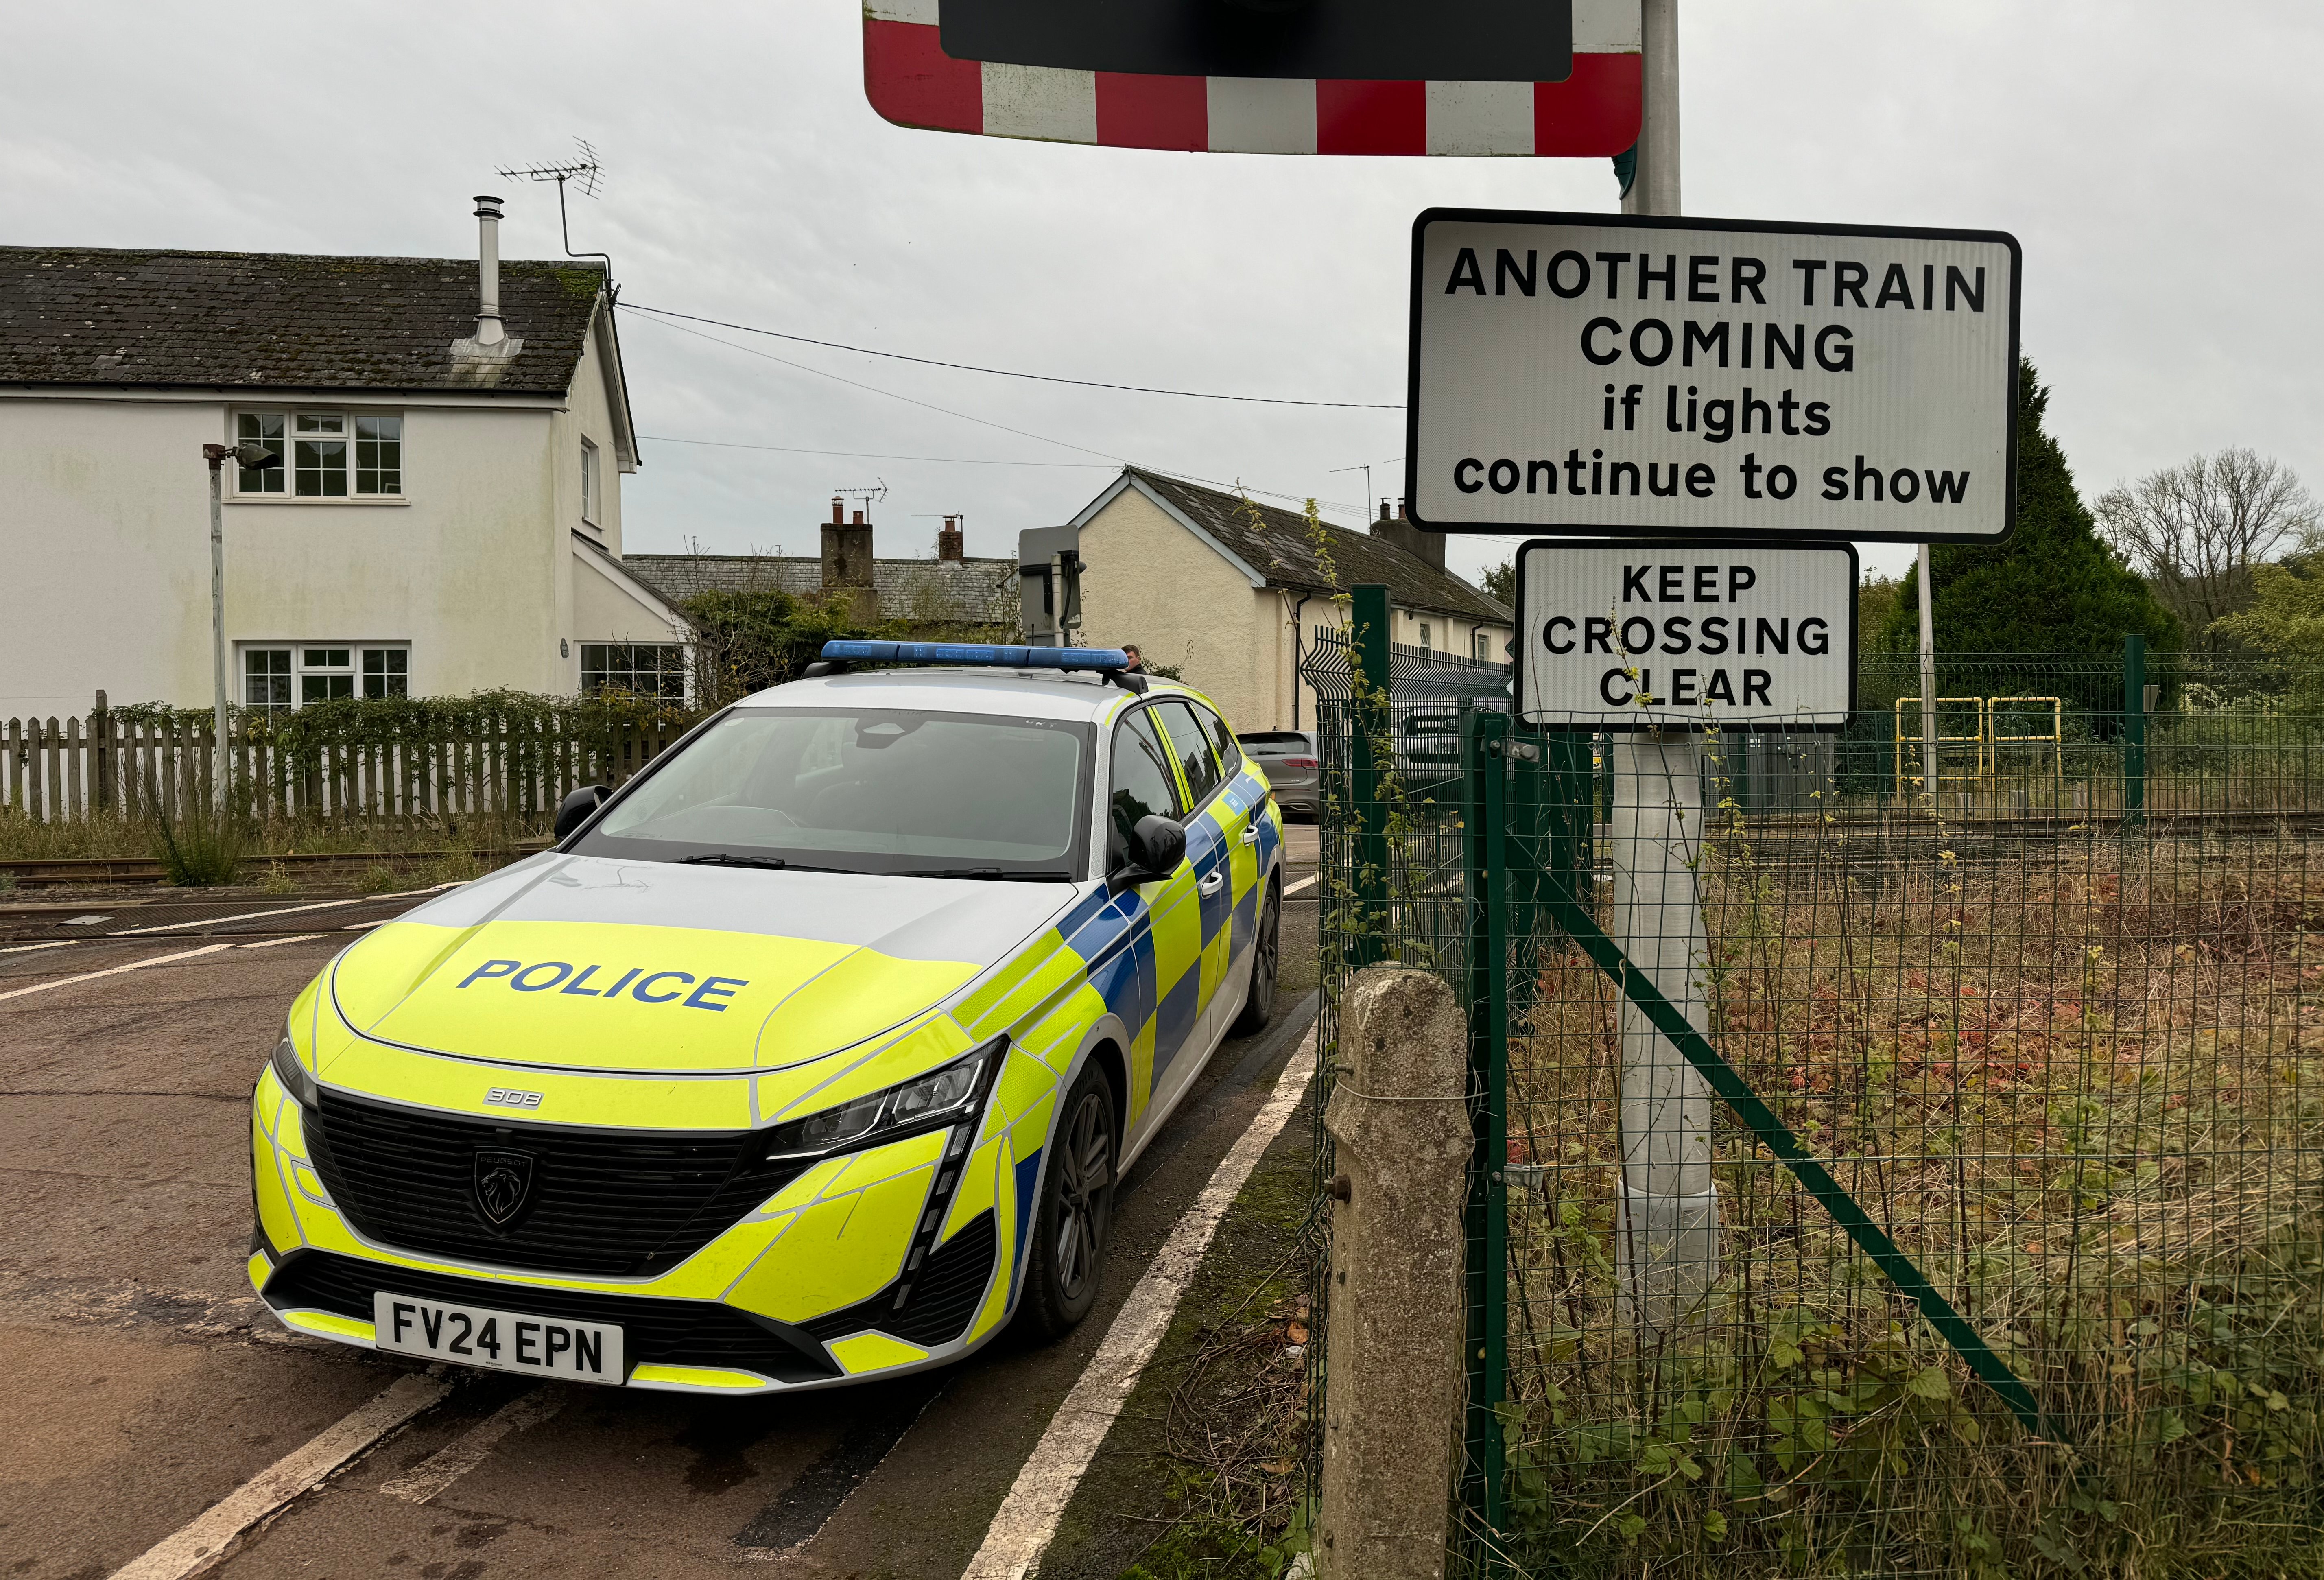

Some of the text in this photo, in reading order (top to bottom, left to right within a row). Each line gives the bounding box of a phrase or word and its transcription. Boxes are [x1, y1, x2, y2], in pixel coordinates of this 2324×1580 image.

[1444, 247, 1985, 312] ANOTHER TRAIN
[1581, 317, 1853, 372] COMING
[1604, 384, 1830, 443] if lights
[1454, 449, 1970, 503] continue to show
[1623, 566, 1756, 602] KEEP
[1543, 616, 1828, 655] CROSSING
[1600, 668, 1772, 706] CLEAR
[456, 960, 749, 1012] POLICE
[488, 1089, 542, 1105] 308
[481, 1157, 527, 1167] PEUGEOT
[393, 1302, 601, 1374] FV24 EPN
